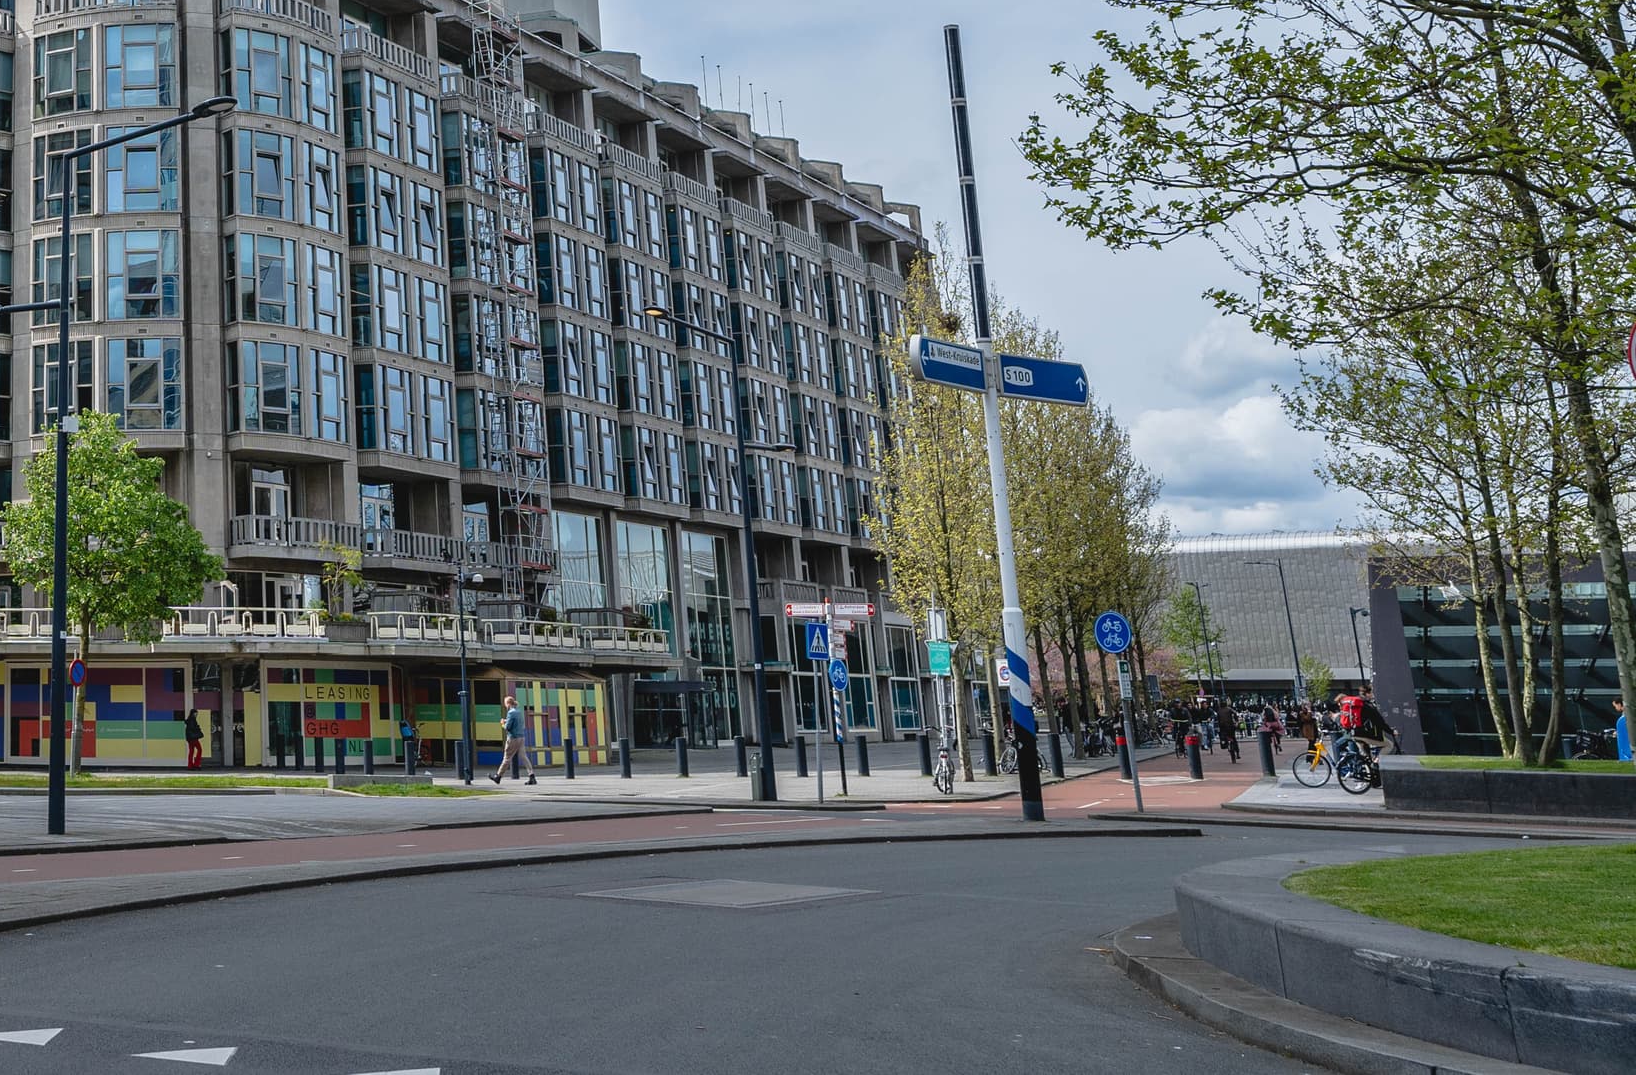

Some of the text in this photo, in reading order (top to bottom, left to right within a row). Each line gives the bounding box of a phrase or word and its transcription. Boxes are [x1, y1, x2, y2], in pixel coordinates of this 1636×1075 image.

[1005, 369, 1031, 383] S 100
[305, 686, 370, 700] LEASING
[306, 721, 339, 735] GHG
[348, 740, 365, 753] NL
